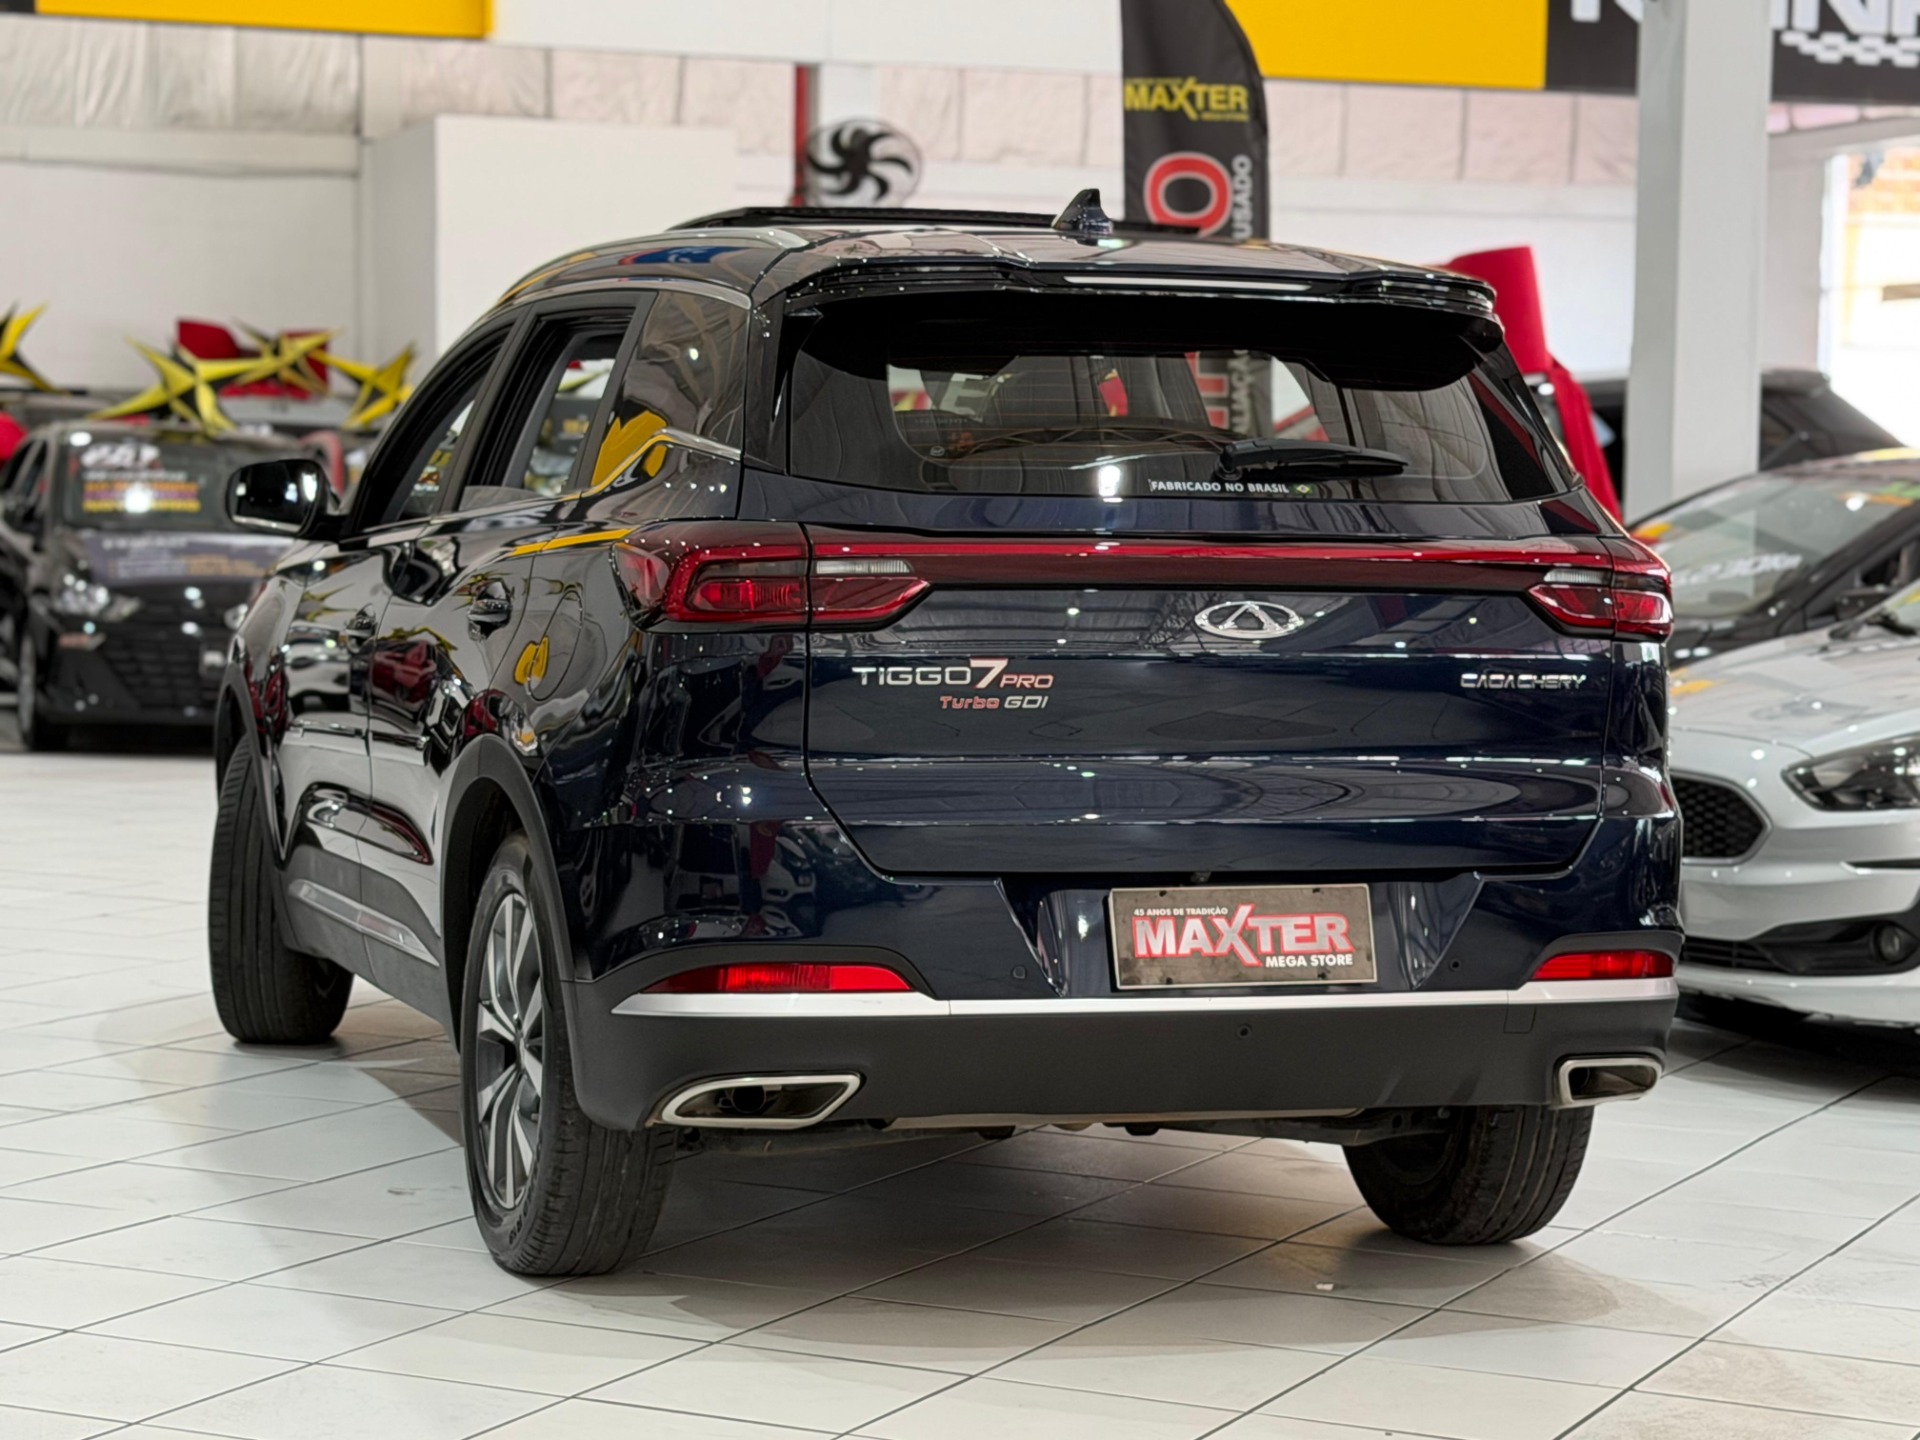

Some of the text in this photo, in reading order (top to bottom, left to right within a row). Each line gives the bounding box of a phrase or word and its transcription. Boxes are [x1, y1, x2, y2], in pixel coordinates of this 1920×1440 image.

[1124, 76, 1249, 121] MAXTER
[1232, 155, 1253, 240] USADO
[1151, 480, 1289, 494] FABRICADO NO BRASIL
[852, 657, 1054, 689] TIGGO 7 PRO
[1517, 674, 1587, 689] CHERY
[940, 696, 1049, 709] Turbo GDI
[1146, 908, 1171, 916] ANOS
[1173, 908, 1184, 916] DE
[1186, 906, 1228, 916] TRADIÇÃO
[1132, 904, 1355, 967] MAXTER
[1265, 954, 1353, 968] MEGA STORE
